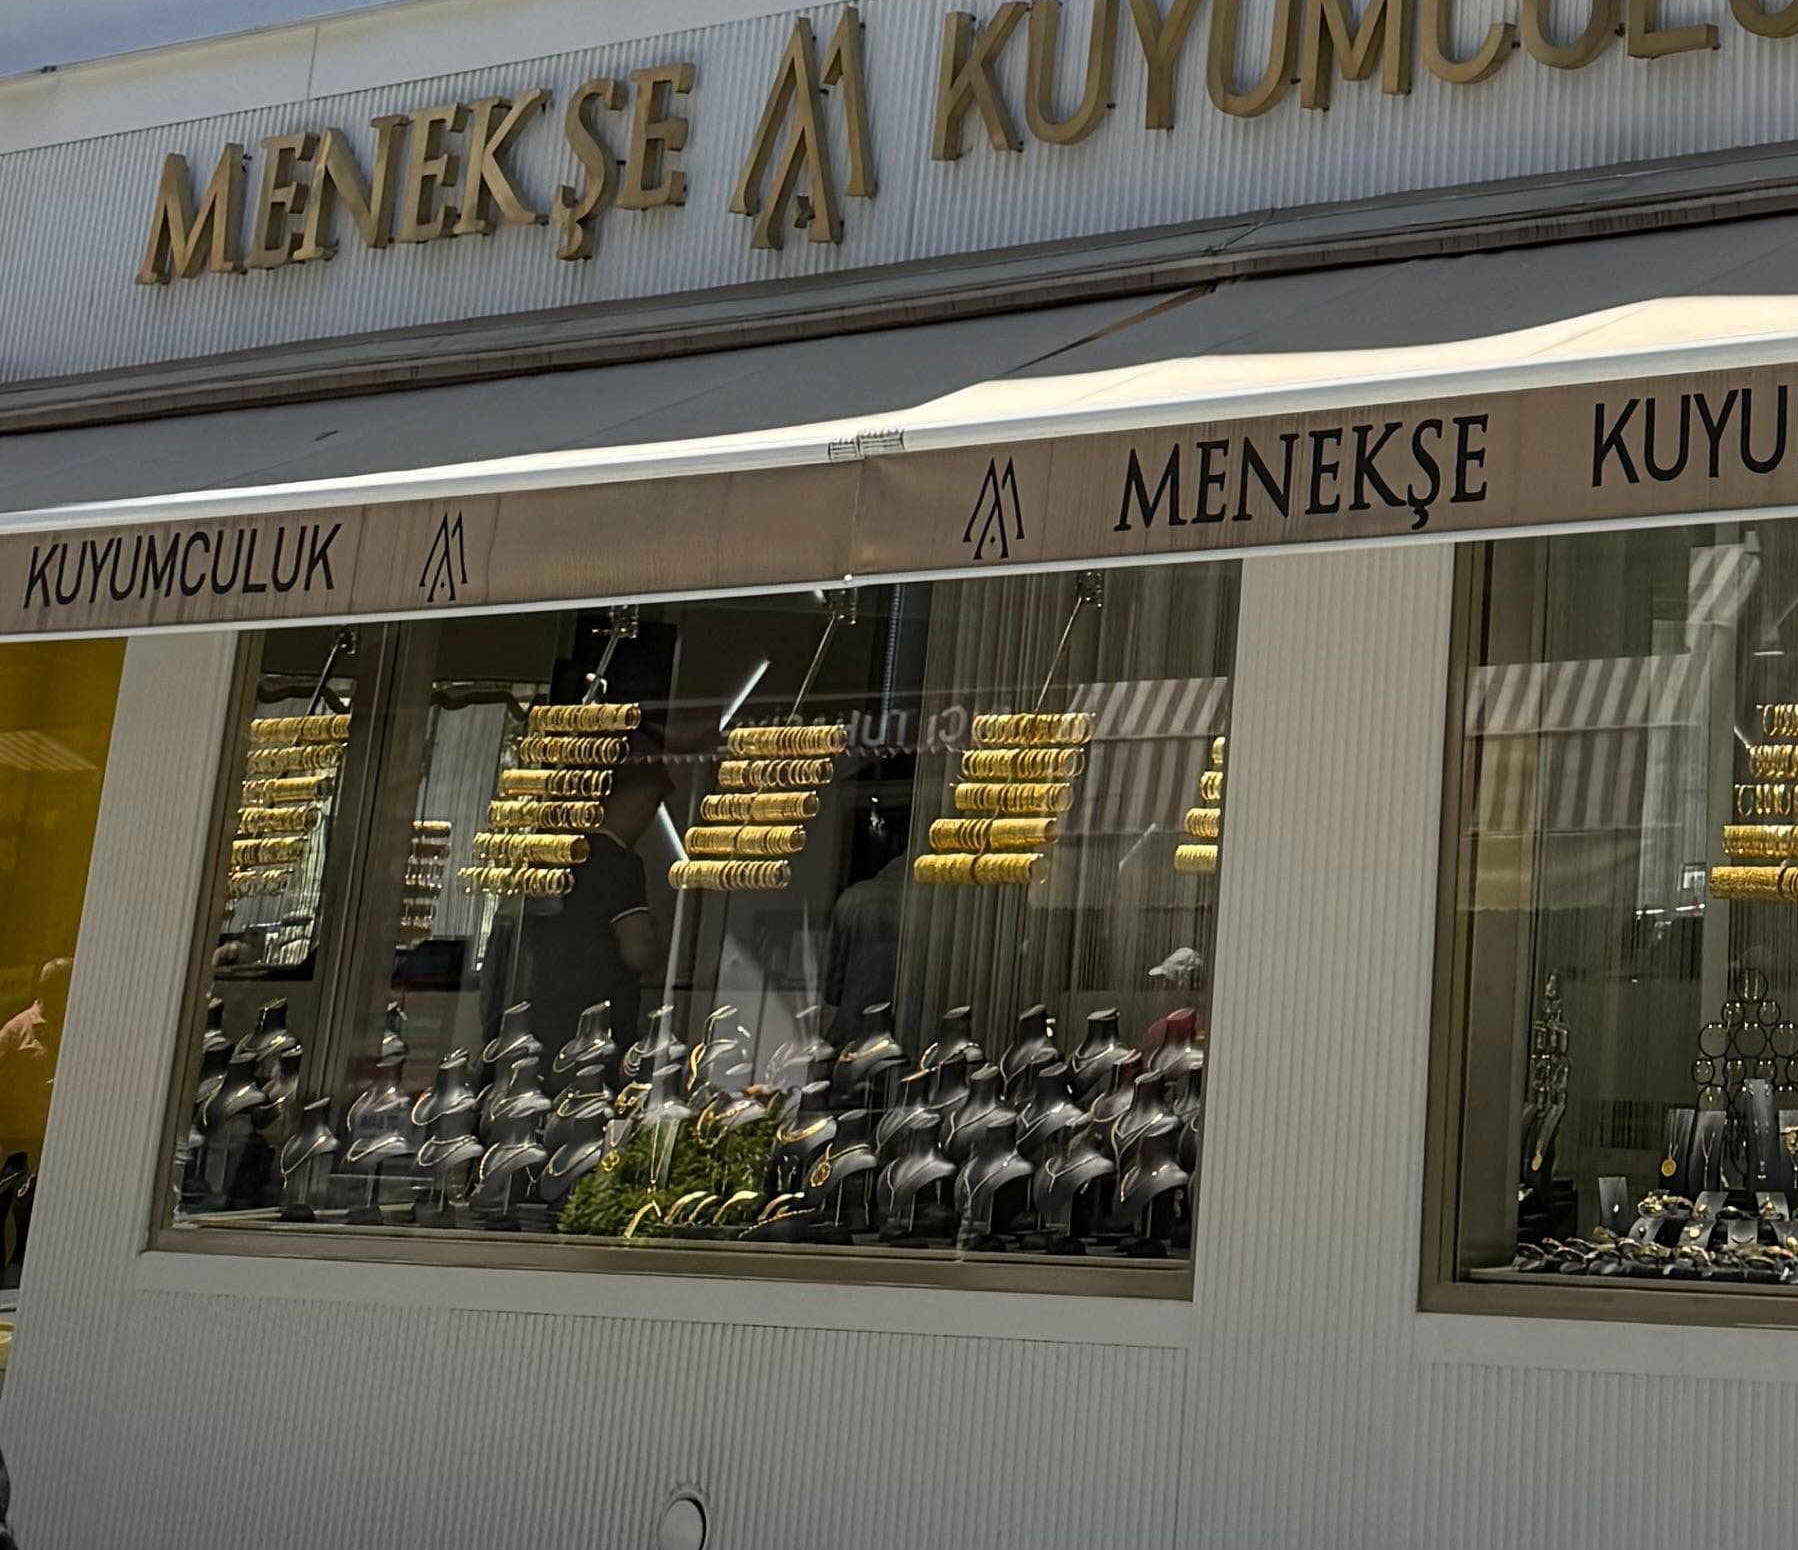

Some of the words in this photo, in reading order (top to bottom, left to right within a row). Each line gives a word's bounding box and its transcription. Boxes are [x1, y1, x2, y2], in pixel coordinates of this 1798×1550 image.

[135, 61, 697, 287] MENEKŞE
[1113, 413, 1490, 531] MENEKŞE
[23, 522, 343, 610] KUYUMCULUK
